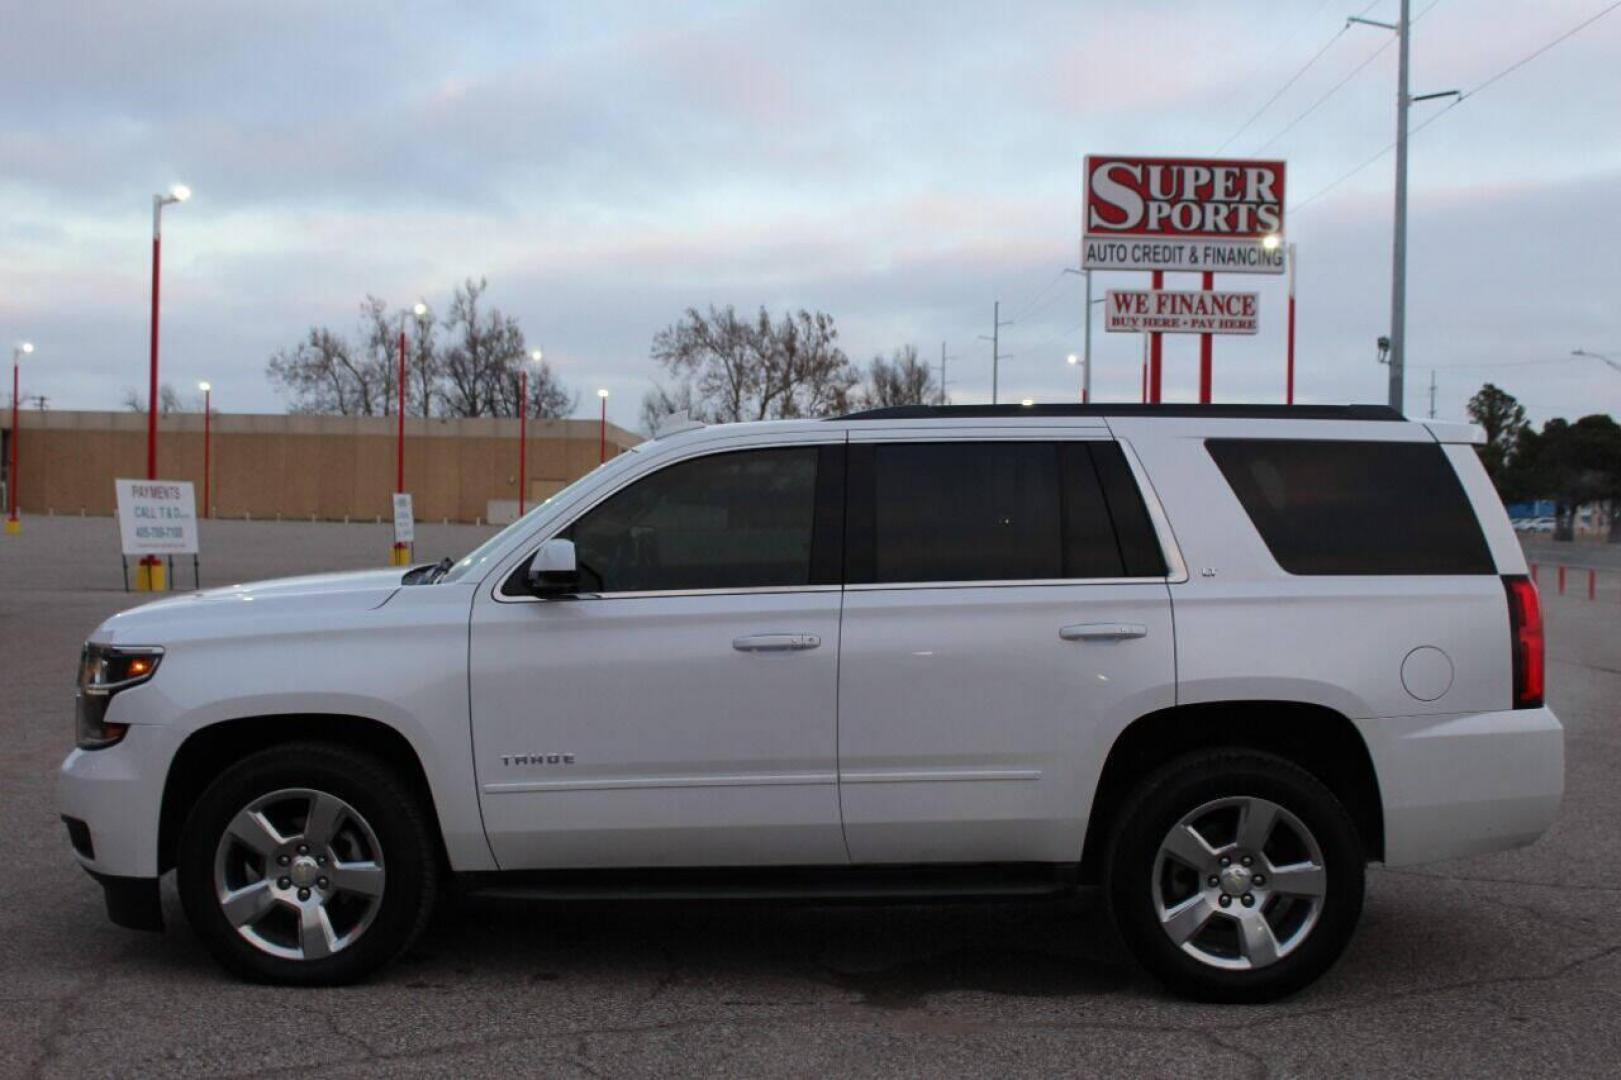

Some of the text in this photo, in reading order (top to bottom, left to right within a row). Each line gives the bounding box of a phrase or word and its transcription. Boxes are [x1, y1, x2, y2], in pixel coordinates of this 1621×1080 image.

[1091, 161, 1279, 230] SUPER
[1087, 244, 1283, 267] AUTO CREDIT & FINANCING
[1112, 293, 1256, 317] WE FINANCE
[1112, 317, 1257, 330] BUY HERE PAY HERE
[131, 485, 181, 500] PAYMENTS
[500, 753, 576, 767] TAHOE
